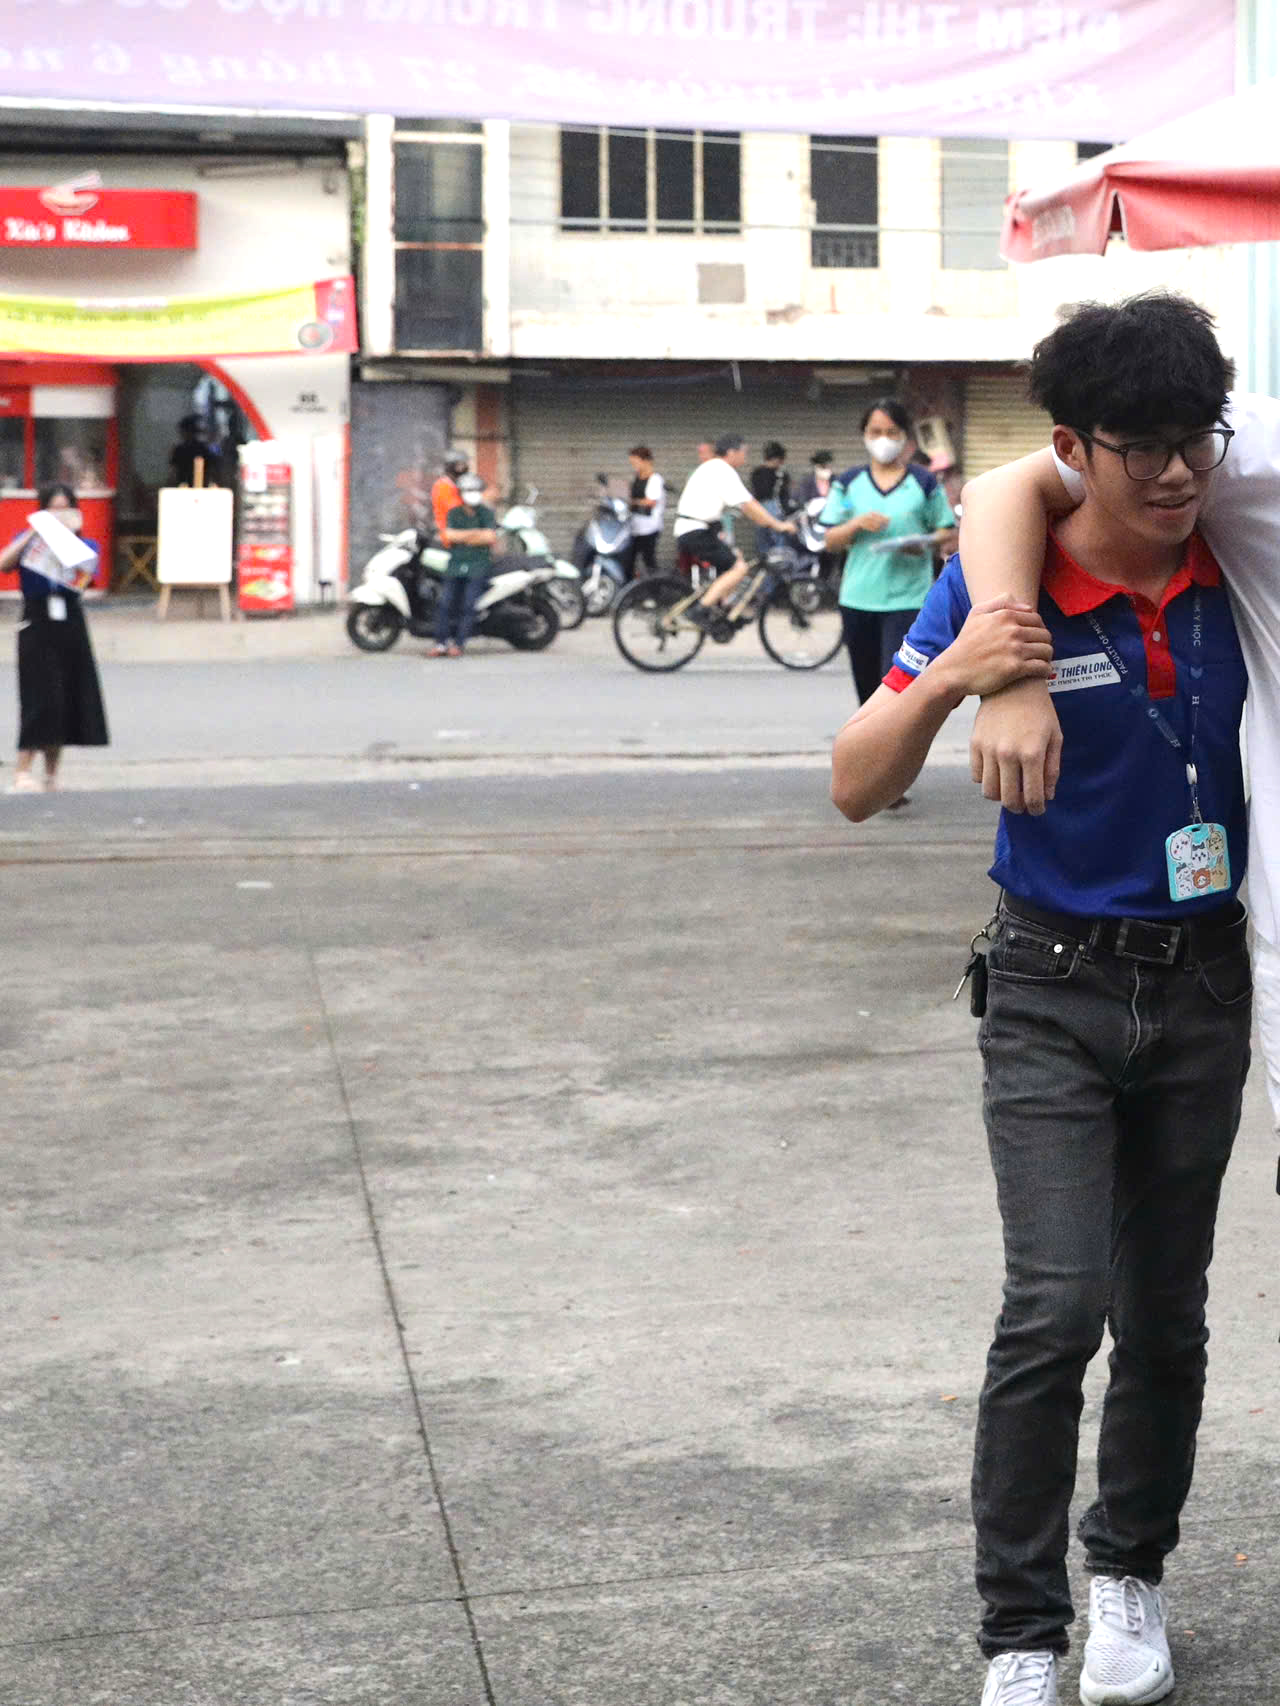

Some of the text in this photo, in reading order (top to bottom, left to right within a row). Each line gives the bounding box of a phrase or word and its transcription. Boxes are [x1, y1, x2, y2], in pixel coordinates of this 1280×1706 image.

[1098, 634, 1109, 645] OF
[1061, 660, 1113, 679] THIÊN LONG
[1105, 645, 1129, 676] FACULTY
